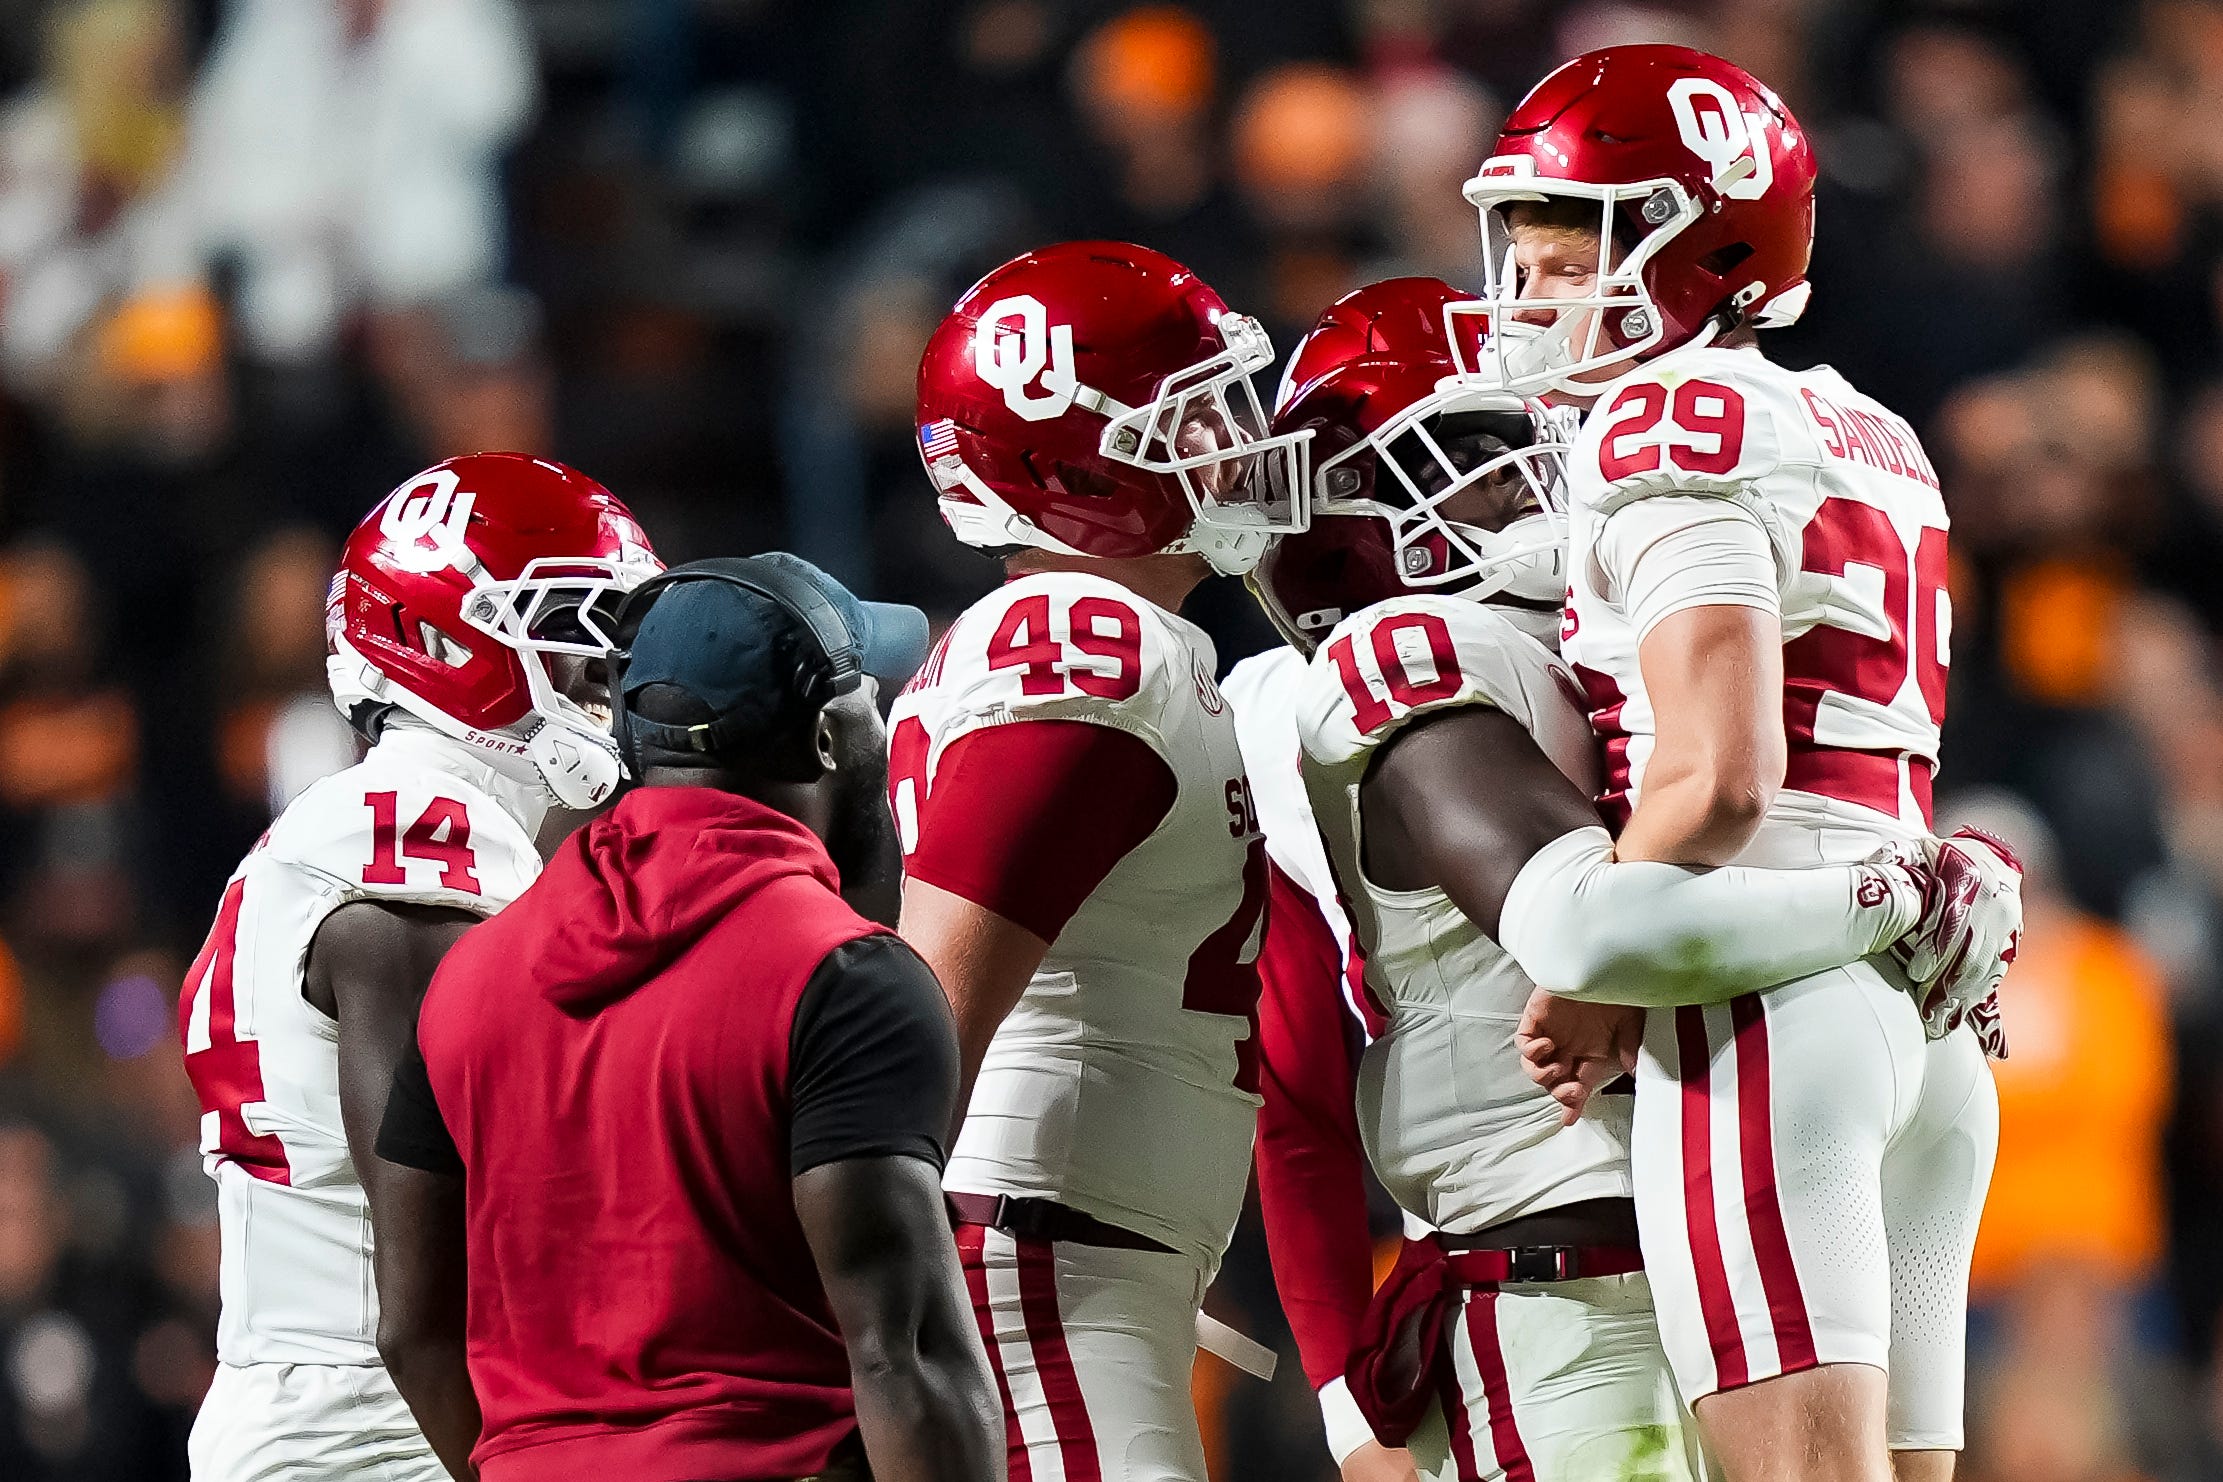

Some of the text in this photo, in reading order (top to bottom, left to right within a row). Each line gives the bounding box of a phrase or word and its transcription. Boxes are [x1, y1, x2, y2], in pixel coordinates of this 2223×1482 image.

[1667, 78, 1774, 200] OU
[975, 294, 1076, 421] OU
[1600, 379, 1745, 482] 29
[379, 469, 477, 573] OU
[987, 595, 1142, 701] 49
[1328, 612, 1464, 736] 10
[465, 730, 515, 754] SPORT
[362, 790, 482, 896] 14
